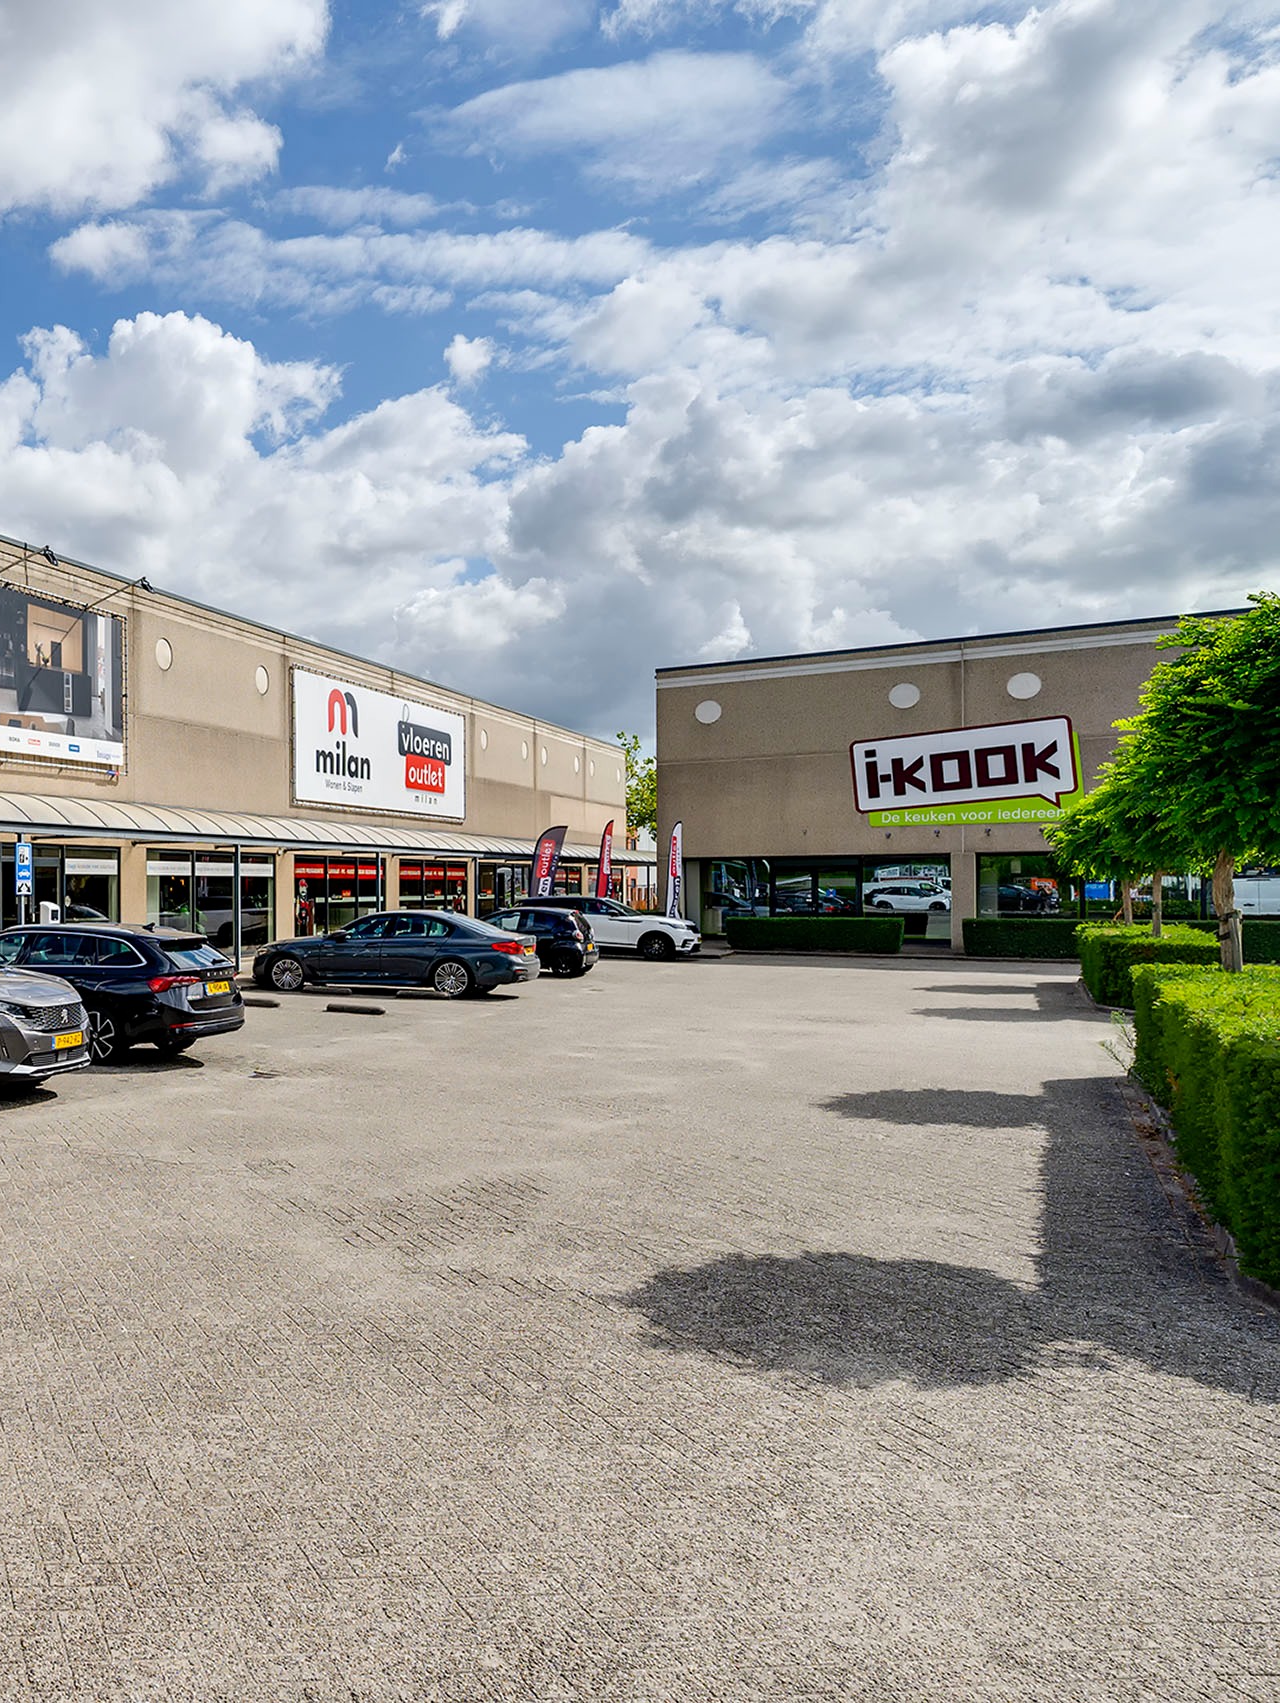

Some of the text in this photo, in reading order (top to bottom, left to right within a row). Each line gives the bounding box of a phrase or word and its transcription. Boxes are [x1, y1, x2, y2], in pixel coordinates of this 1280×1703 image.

[401, 728, 450, 761] vloeren
[315, 741, 371, 780] milan
[325, 779, 342, 790] Wonen
[408, 762, 444, 788] outlet
[414, 794, 438, 805] milan
[881, 812, 900, 823] De
[904, 810, 956, 822] keuken
[961, 811, 993, 821] voor
[540, 842, 553, 875] outlet
